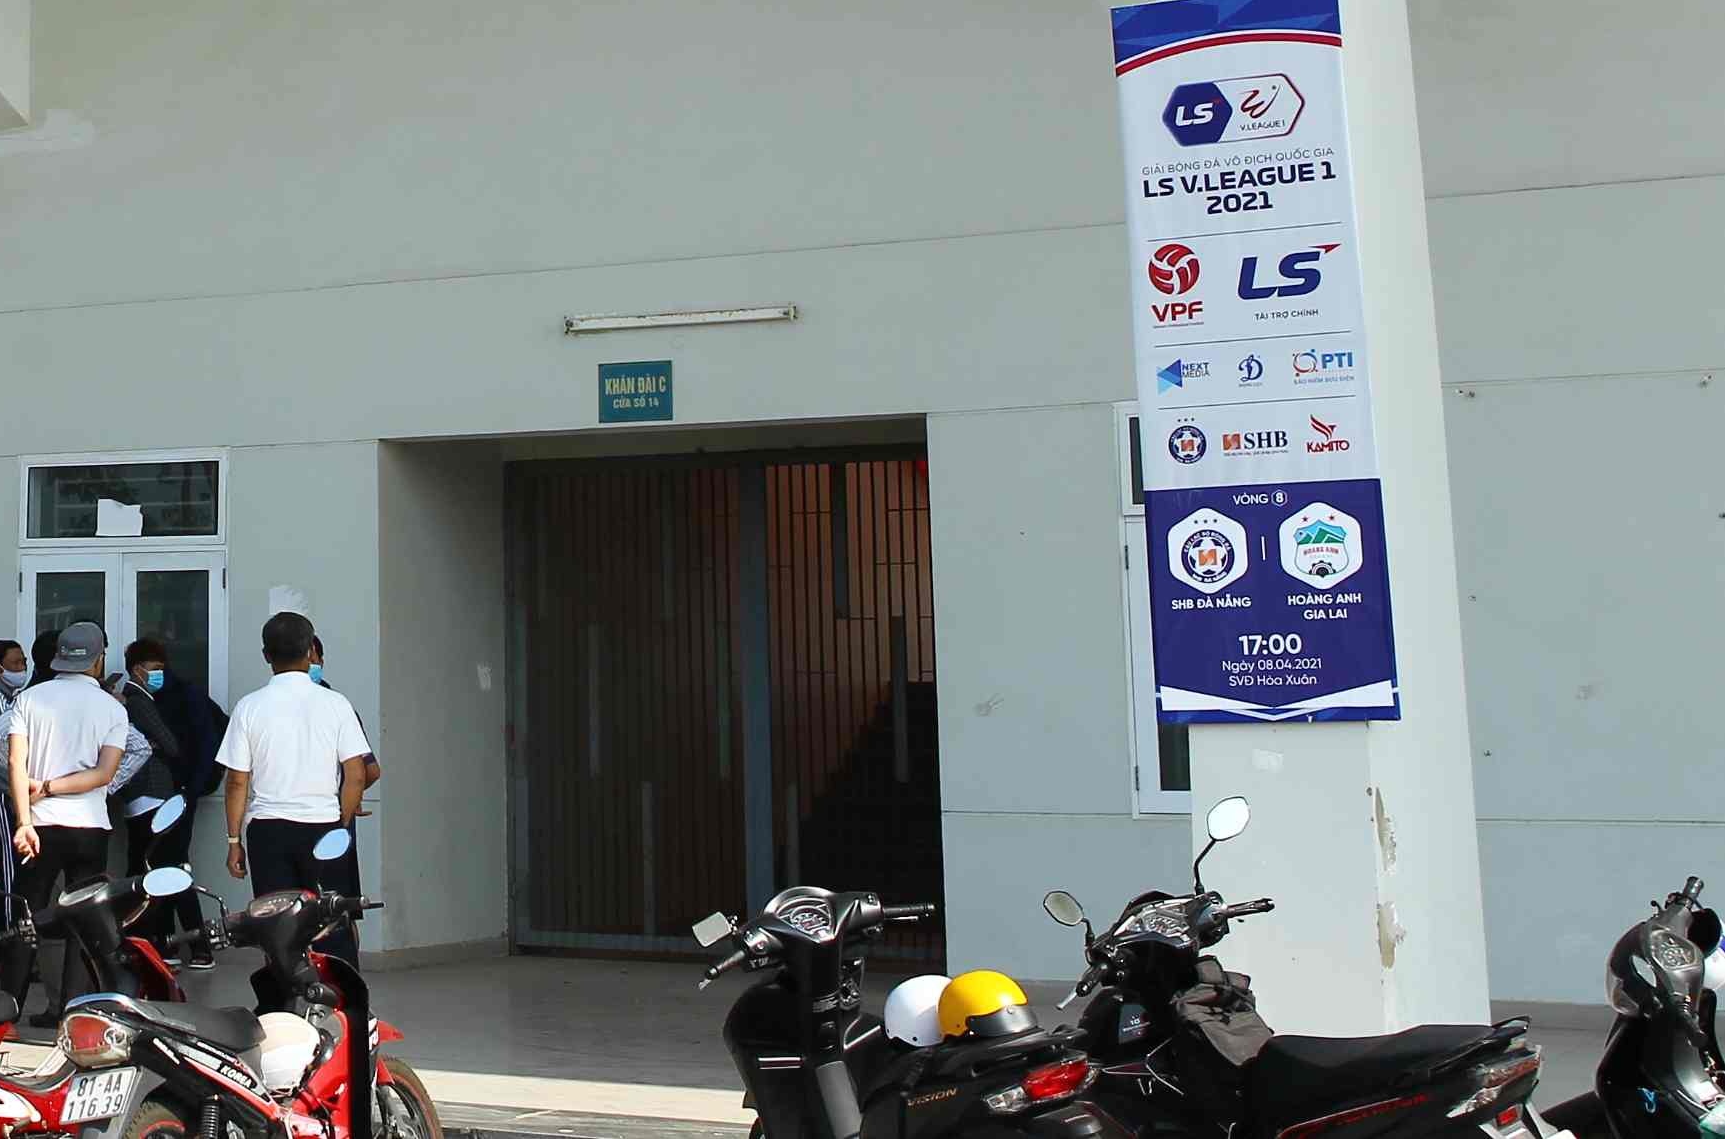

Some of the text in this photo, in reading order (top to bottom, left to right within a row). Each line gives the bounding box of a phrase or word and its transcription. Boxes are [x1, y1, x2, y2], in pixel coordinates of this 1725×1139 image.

[1175, 101, 1214, 126] LS
[1276, 148, 1310, 162] QUỐC
[1314, 148, 1334, 157] GIA
[1143, 161, 1336, 198] LS V.LEAGUE 1
[1206, 191, 1273, 214] 2021
[1237, 249, 1322, 301] LS
[1151, 301, 1203, 323] VPF
[1182, 362, 1209, 371] NEXT
[1321, 352, 1353, 370] PTI
[1182, 369, 1210, 378] MEDIA
[604, 374, 666, 395] KHÁN ĐÀI C
[1244, 430, 1288, 451] SHB
[1307, 440, 1350, 453] KAMITO
[1233, 492, 1283, 505] VÒNG 8
[1171, 593, 1252, 610] SHB ĐÀ NẴNG
[1287, 593, 1362, 606] HOÀNG ANH
[1303, 608, 1348, 620] GIA LAI
[1238, 633, 1302, 656] 17:00
[1222, 659, 1322, 674] Ngày 08.04.2021
[1229, 672, 1317, 686] SVĐ Hòa Xuân
[220, 1064, 253, 1088] KOREA
[907, 1087, 958, 1107] VISION
[67, 1094, 124, 1120] 116.39
